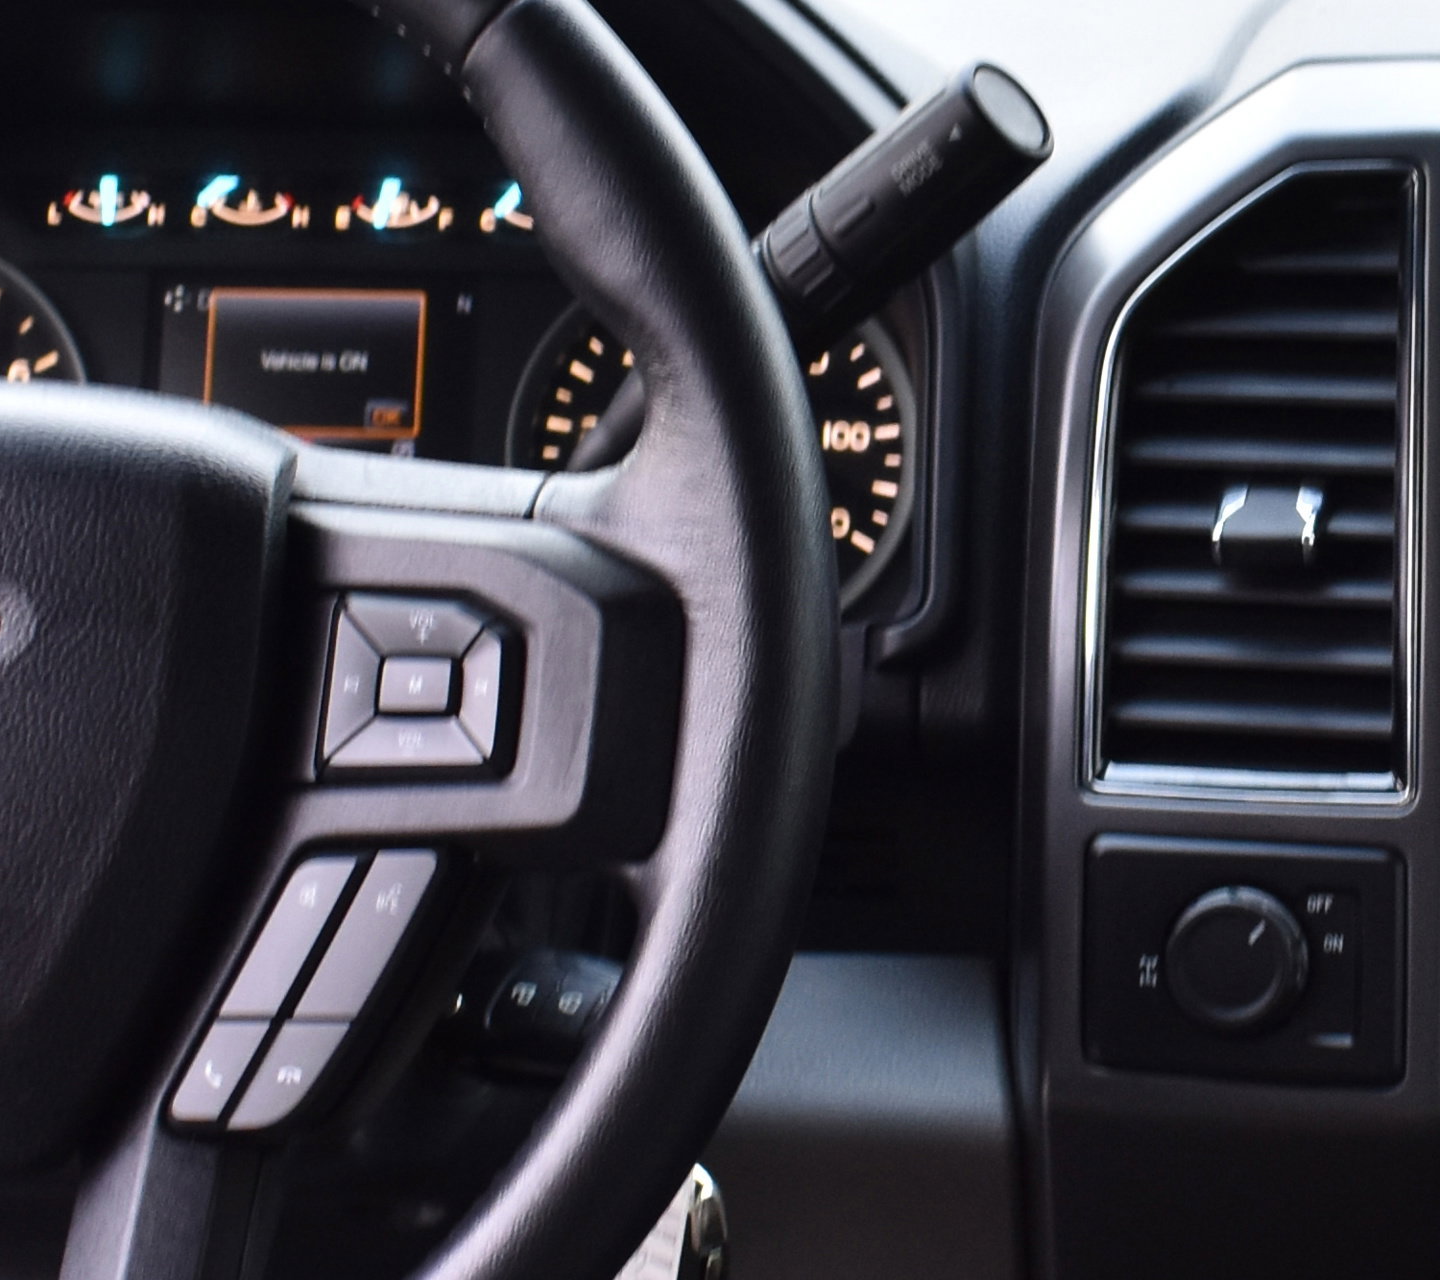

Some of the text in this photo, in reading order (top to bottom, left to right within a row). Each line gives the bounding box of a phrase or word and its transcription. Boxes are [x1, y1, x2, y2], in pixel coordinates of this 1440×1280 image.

[338, 351, 369, 371] ON
[822, 419, 871, 452] 100
[1306, 894, 1334, 914] OFF
[1322, 933, 1345, 954] ON
